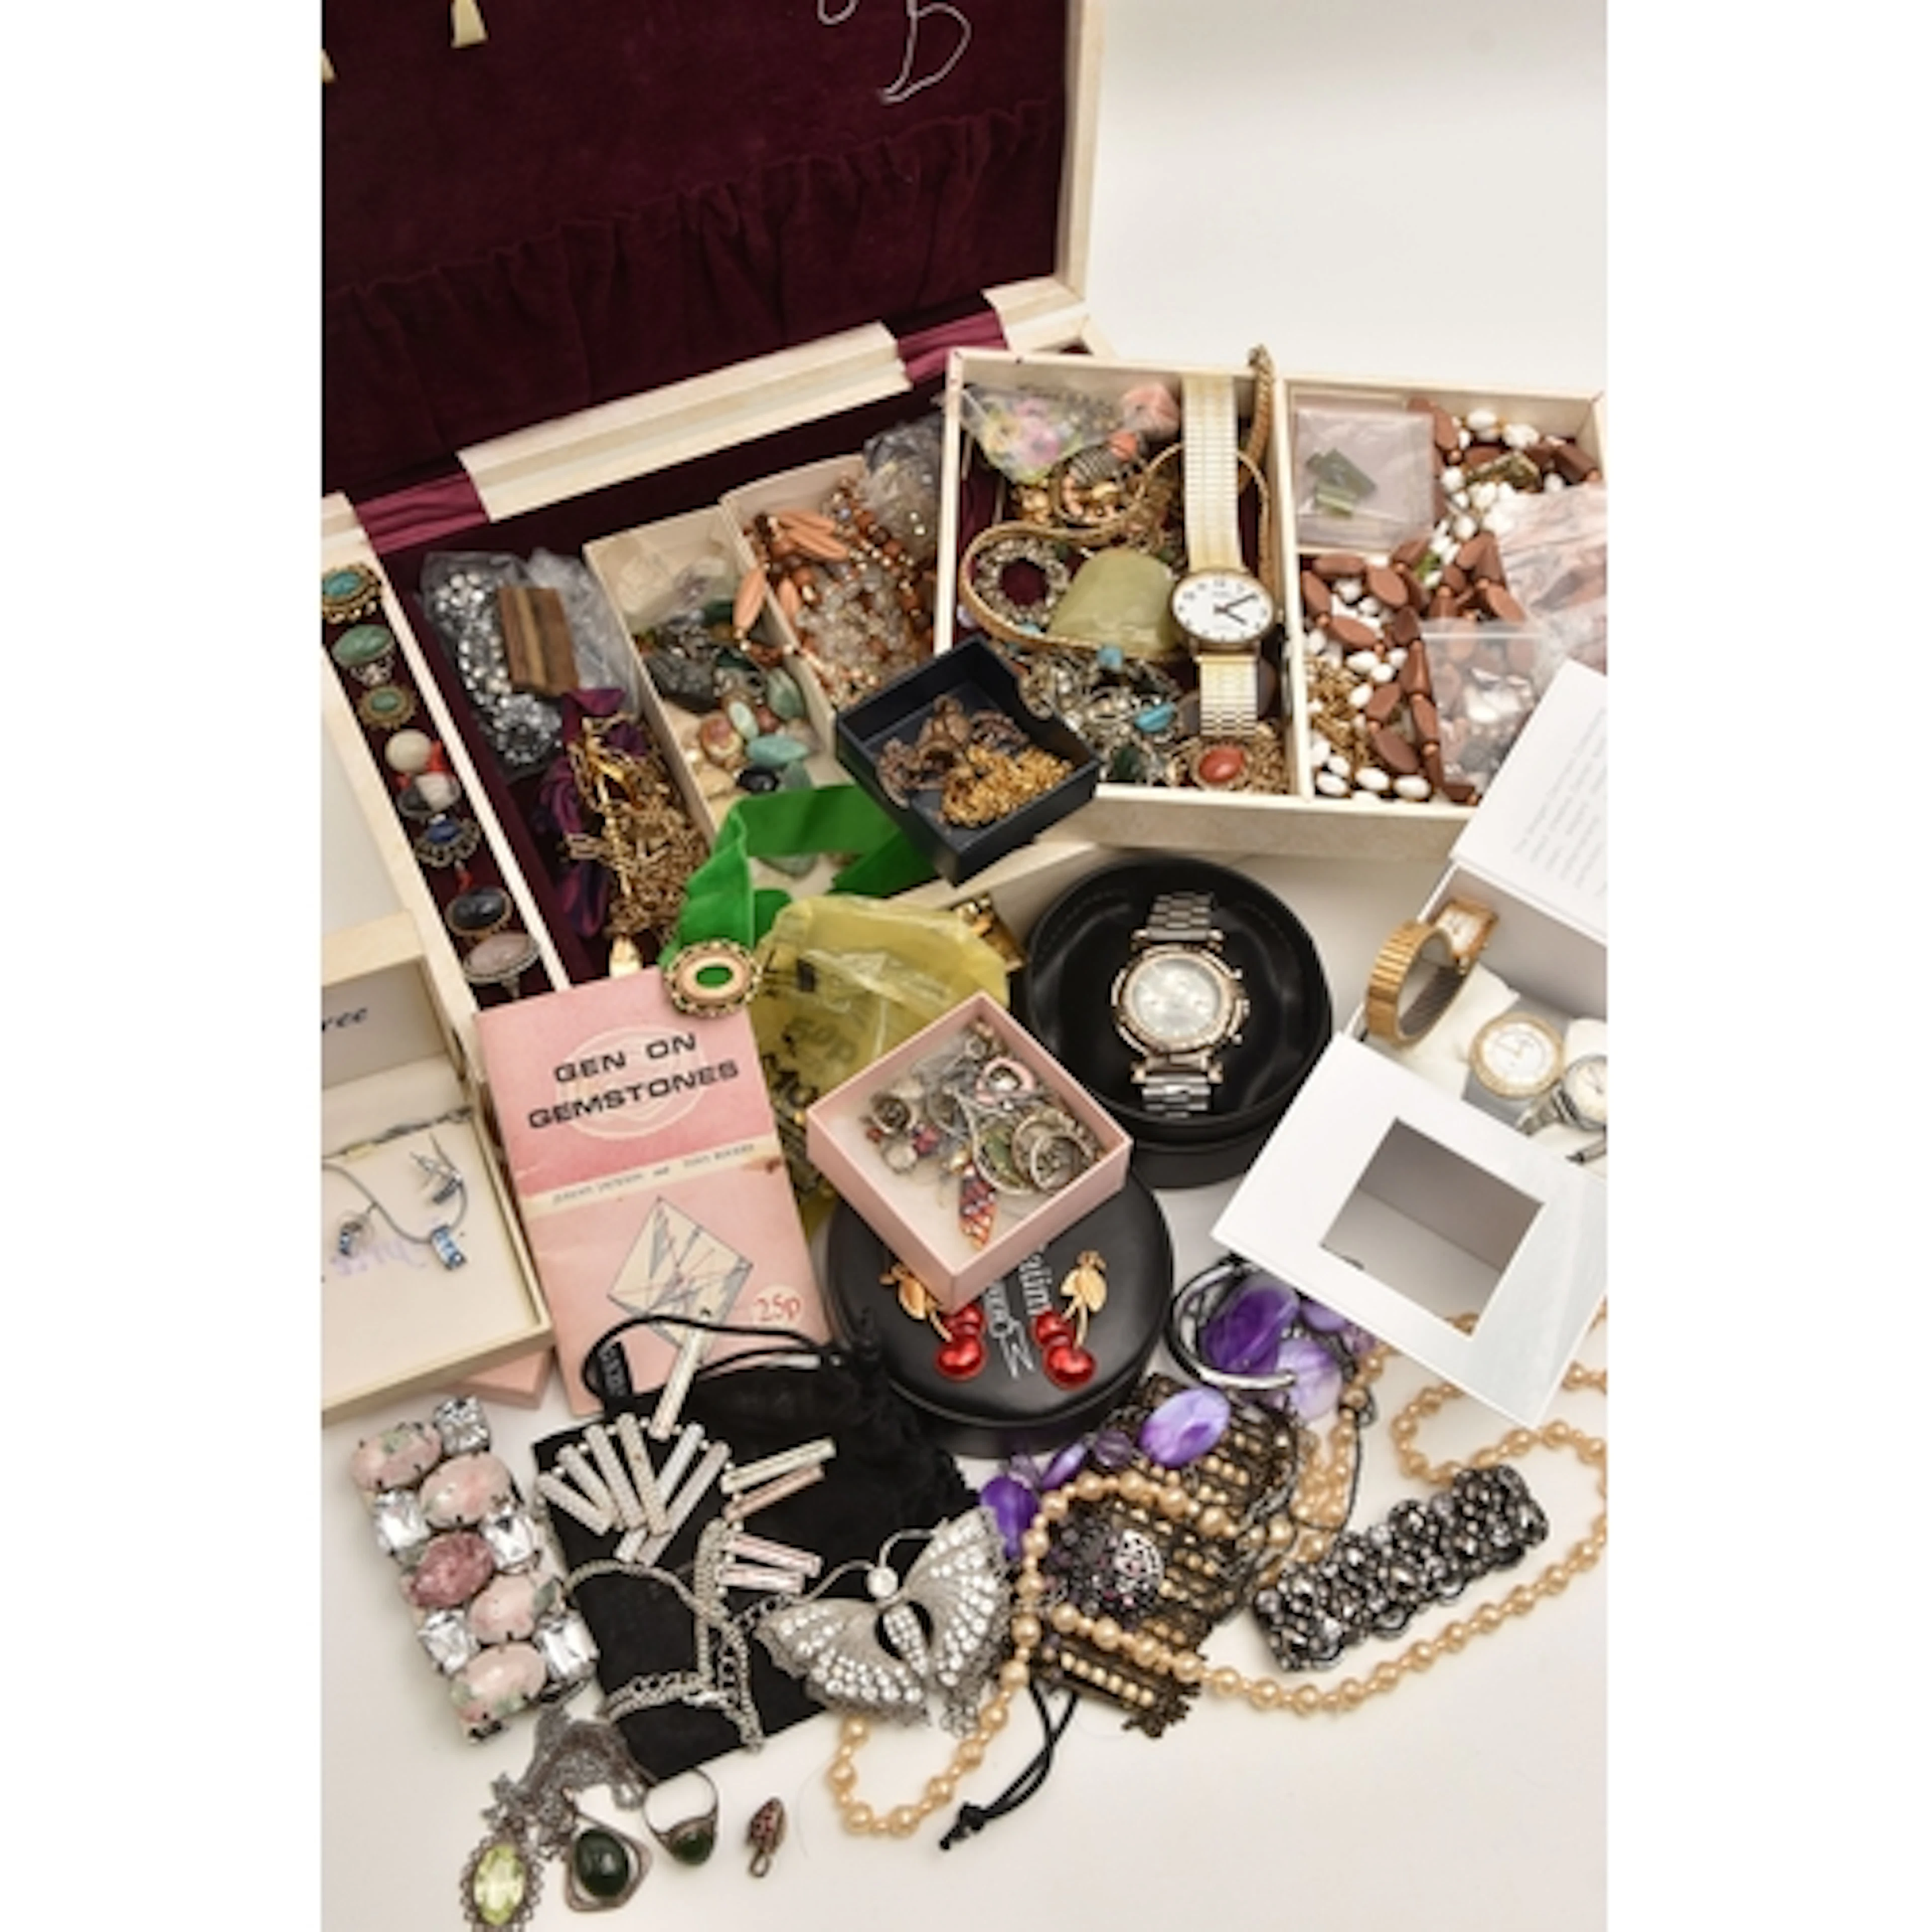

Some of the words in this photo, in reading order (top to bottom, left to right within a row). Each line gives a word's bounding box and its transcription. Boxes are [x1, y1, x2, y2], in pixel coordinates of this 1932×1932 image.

[554, 1051, 626, 1083] GEN
[646, 1032, 697, 1060] ON
[528, 1059, 739, 1129] GEMSTONES
[753, 1291, 801, 1322] 25p
